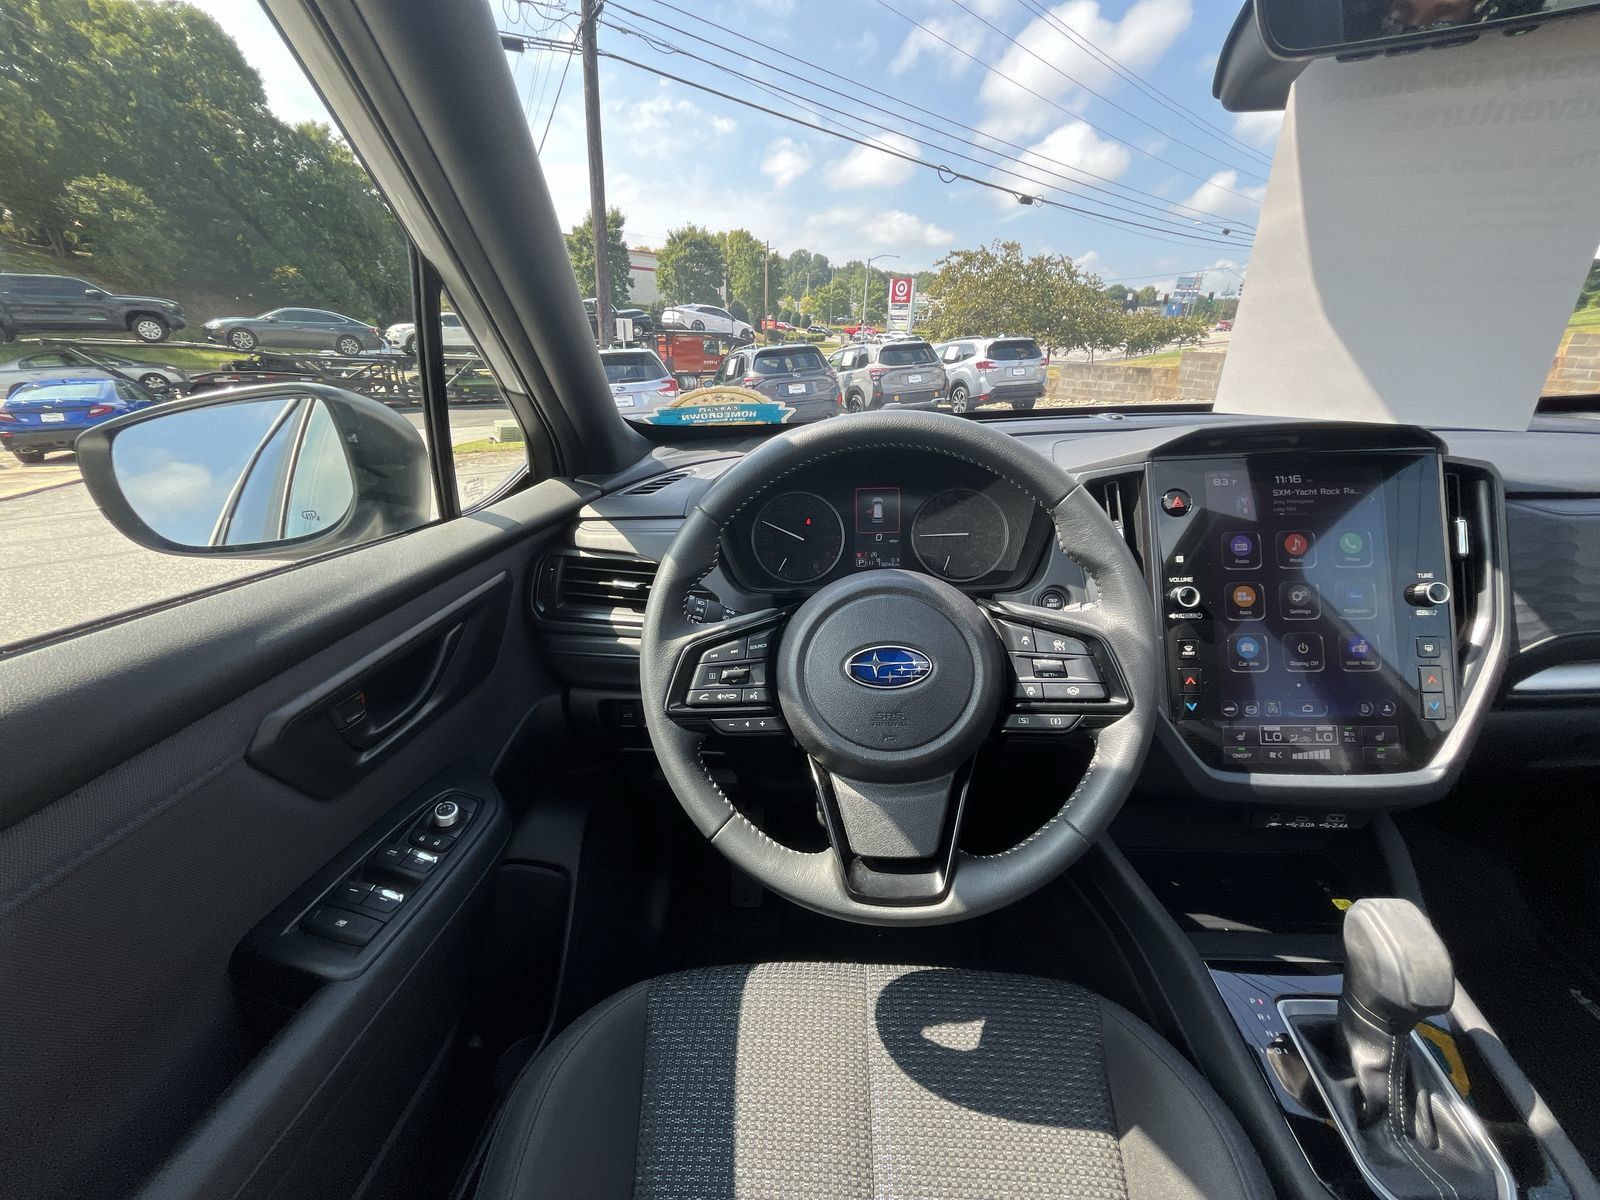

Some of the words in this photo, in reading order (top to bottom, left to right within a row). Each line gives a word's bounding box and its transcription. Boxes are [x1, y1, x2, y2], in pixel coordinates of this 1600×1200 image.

[1274, 474, 1302, 484] 11:16
[1264, 732, 1282, 742] LO
[1315, 732, 1333, 742] LO
